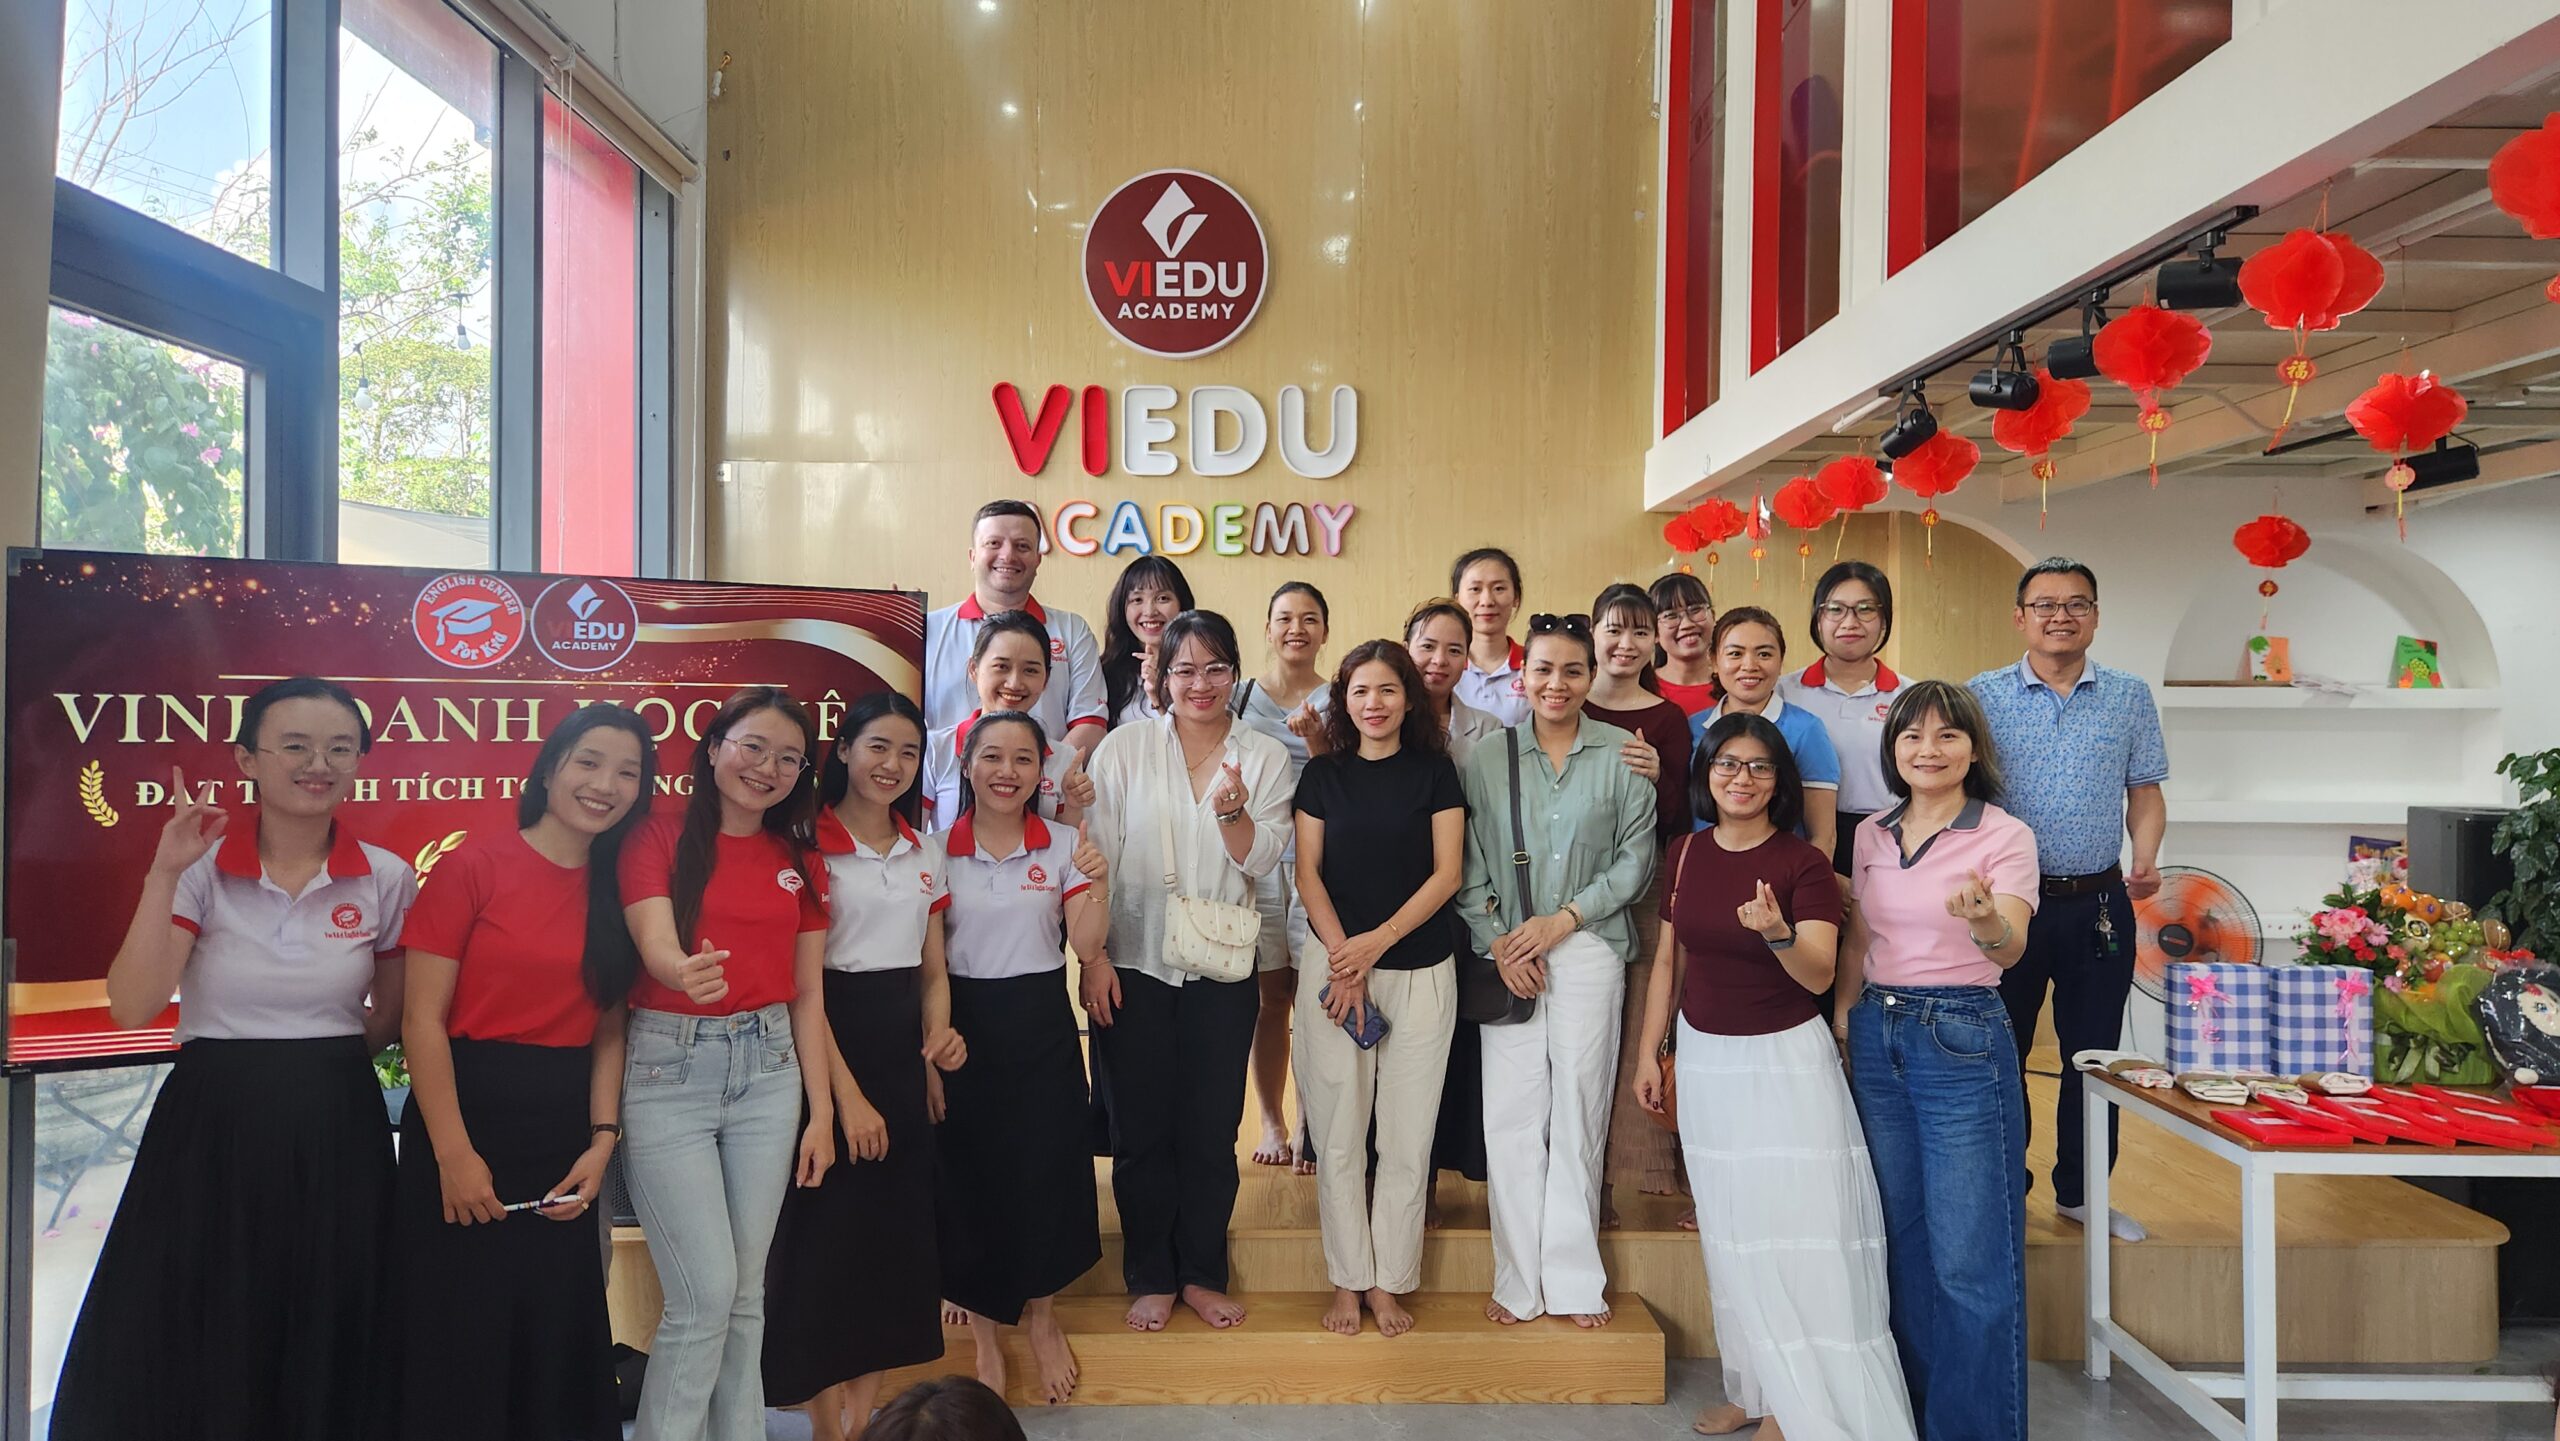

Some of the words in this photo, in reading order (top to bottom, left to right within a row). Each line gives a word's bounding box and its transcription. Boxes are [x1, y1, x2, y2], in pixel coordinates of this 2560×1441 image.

[1104, 261, 1247, 298] VIEDU
[1117, 302, 1235, 320] ACADEMY
[2286, 360, 2308, 379] 福
[991, 381, 1358, 479] VIEDU
[422, 575, 476, 606] ENGLISH
[479, 577, 520, 616] CENTER
[450, 640, 479, 660] For
[481, 631, 509, 659] Kid
[552, 641, 618, 651] ACADEMY
[392, 772, 485, 801] TÍCH
